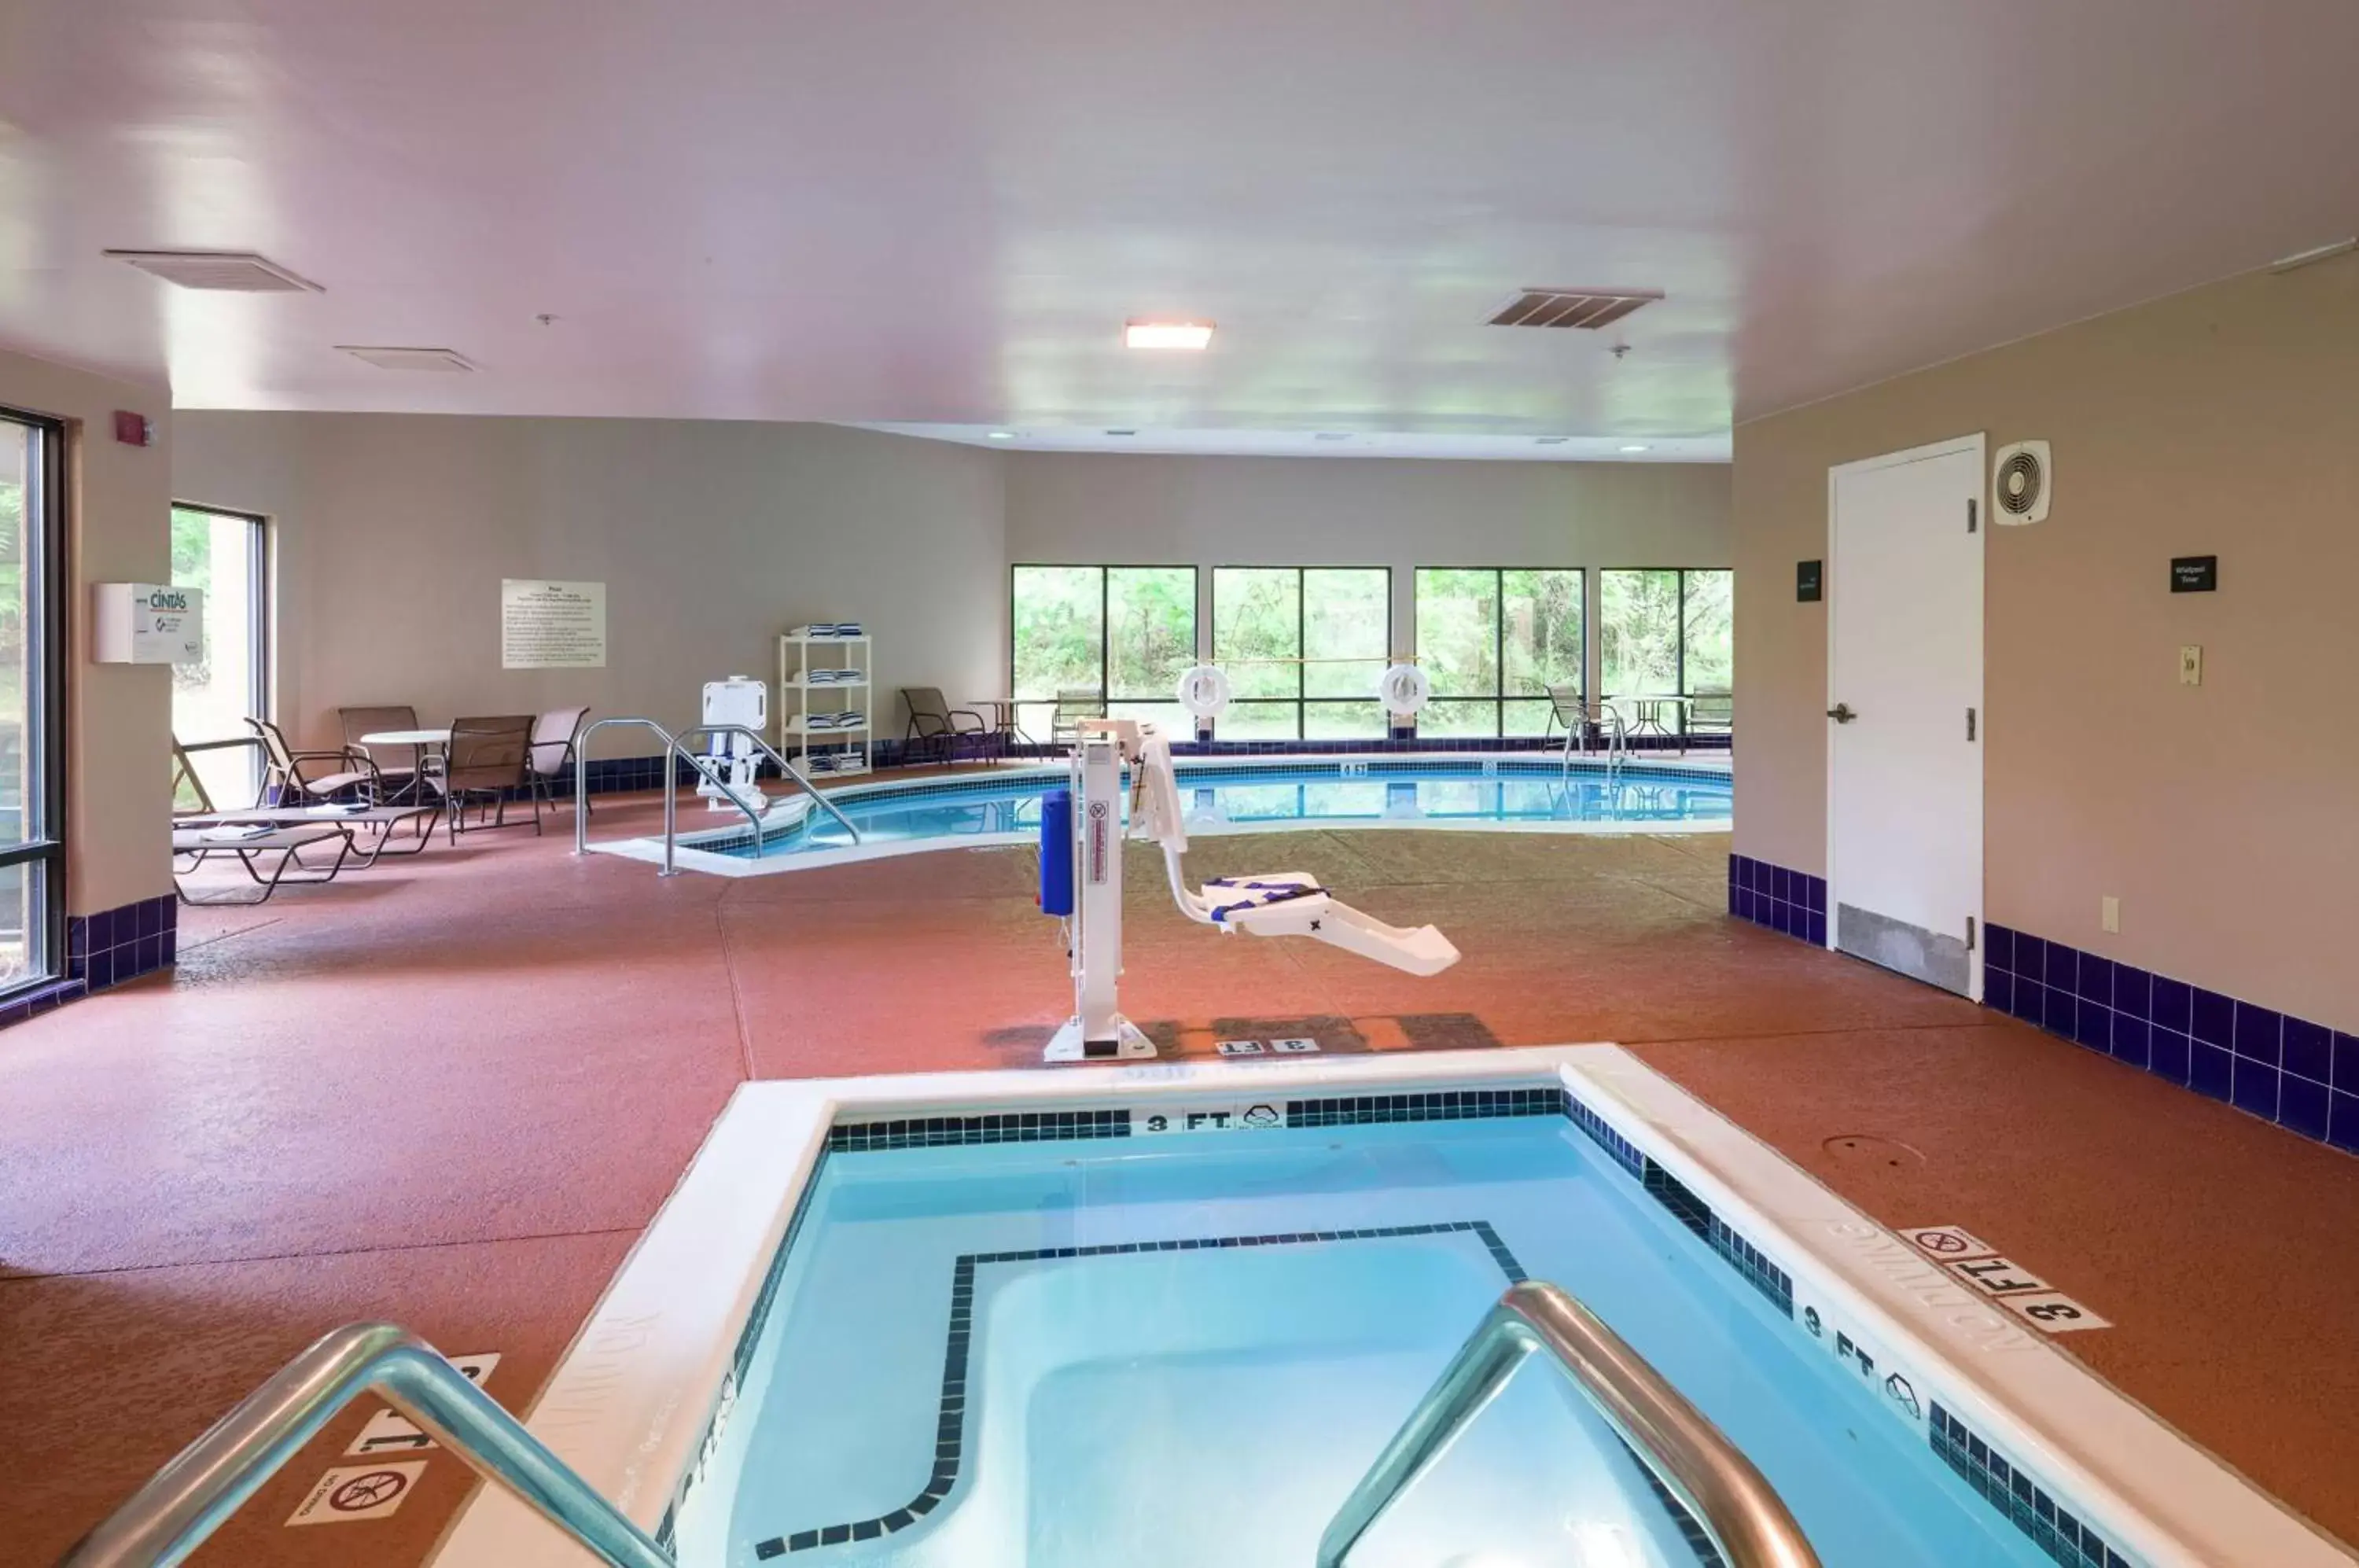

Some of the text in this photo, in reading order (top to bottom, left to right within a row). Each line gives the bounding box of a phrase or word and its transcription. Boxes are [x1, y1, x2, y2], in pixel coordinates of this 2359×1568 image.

[1147, 1115, 1168, 1132] 3
[1805, 1305, 1822, 1338] 3
[2026, 1304, 2081, 1323] 3
